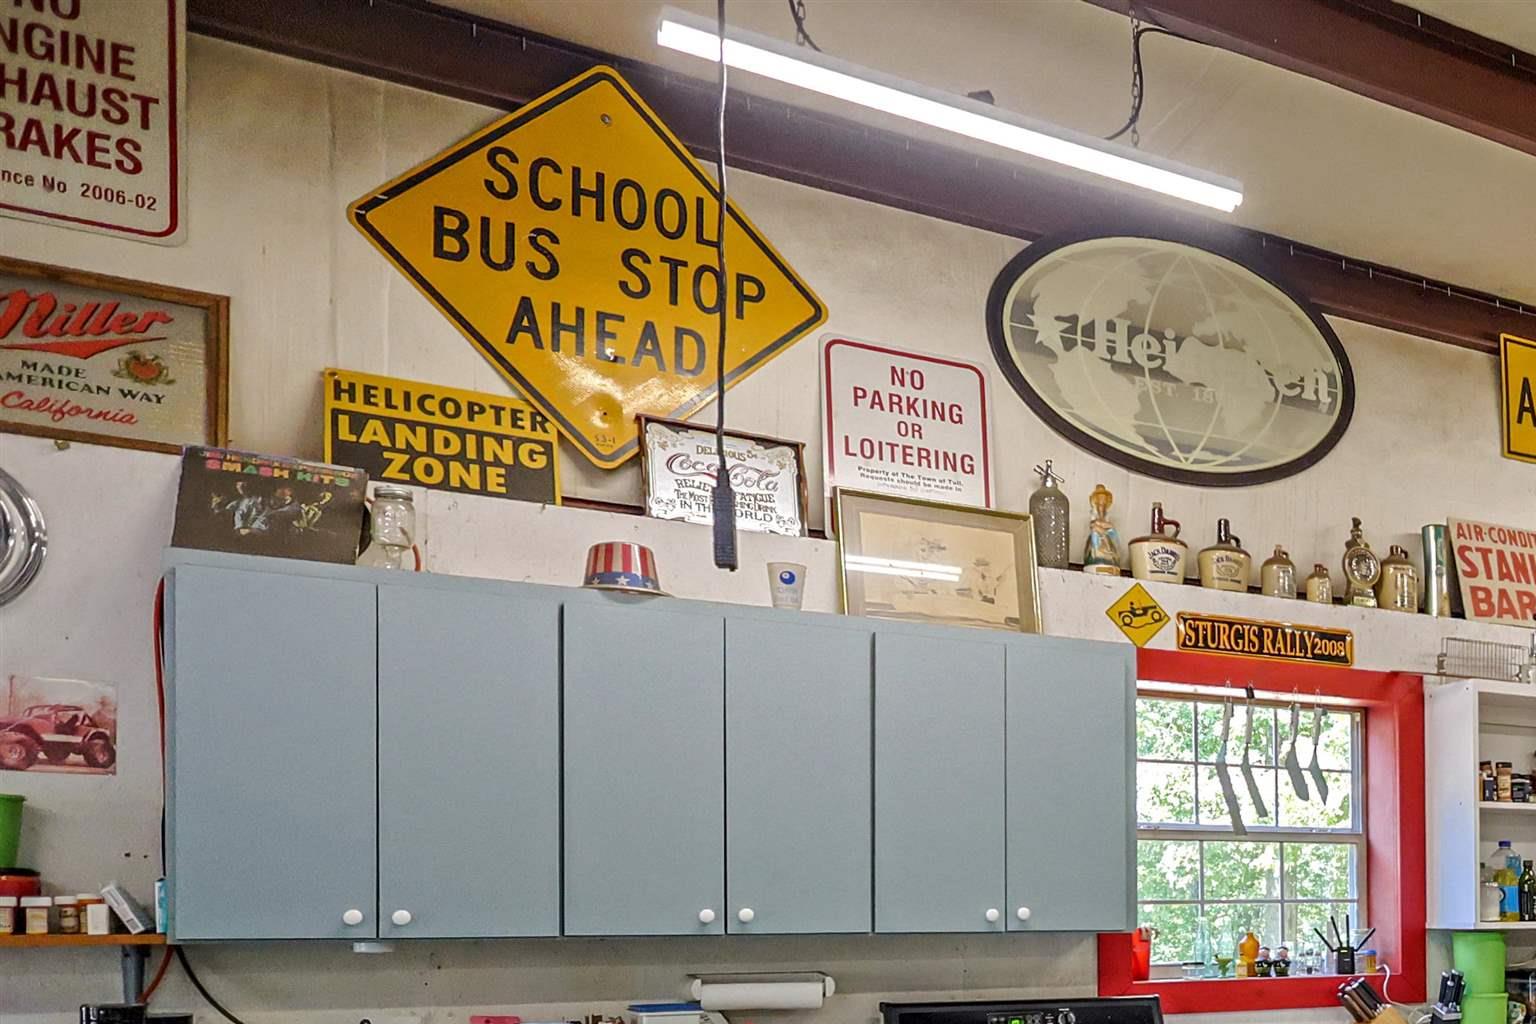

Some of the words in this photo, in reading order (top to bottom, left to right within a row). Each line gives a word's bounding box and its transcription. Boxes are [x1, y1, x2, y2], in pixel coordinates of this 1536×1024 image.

[0, 63, 160, 131] HAUST
[42, 174, 68, 194] No
[80, 183, 157, 211] 2006-02
[484, 146, 721, 249] SCHOOL
[432, 205, 561, 281] BUS
[618, 247, 766, 321] STOP
[506, 296, 707, 378] AHEAD
[21, 360, 87, 379] MADE
[890, 365, 926, 391] NO
[0, 390, 139, 422] California
[118, 388, 166, 405] WAY
[332, 379, 550, 434] HELICOPTER
[853, 386, 964, 426] PARKING
[337, 414, 549, 470] LANDING
[896, 420, 924, 441] OR
[381, 450, 508, 495] ZONE
[843, 434, 976, 476] LOITERING
[734, 510, 774, 523] ORLD
[1185, 619, 1260, 653] STURGIS
[1262, 626, 1315, 658] RALLY
[1314, 637, 1346, 657] 2008
